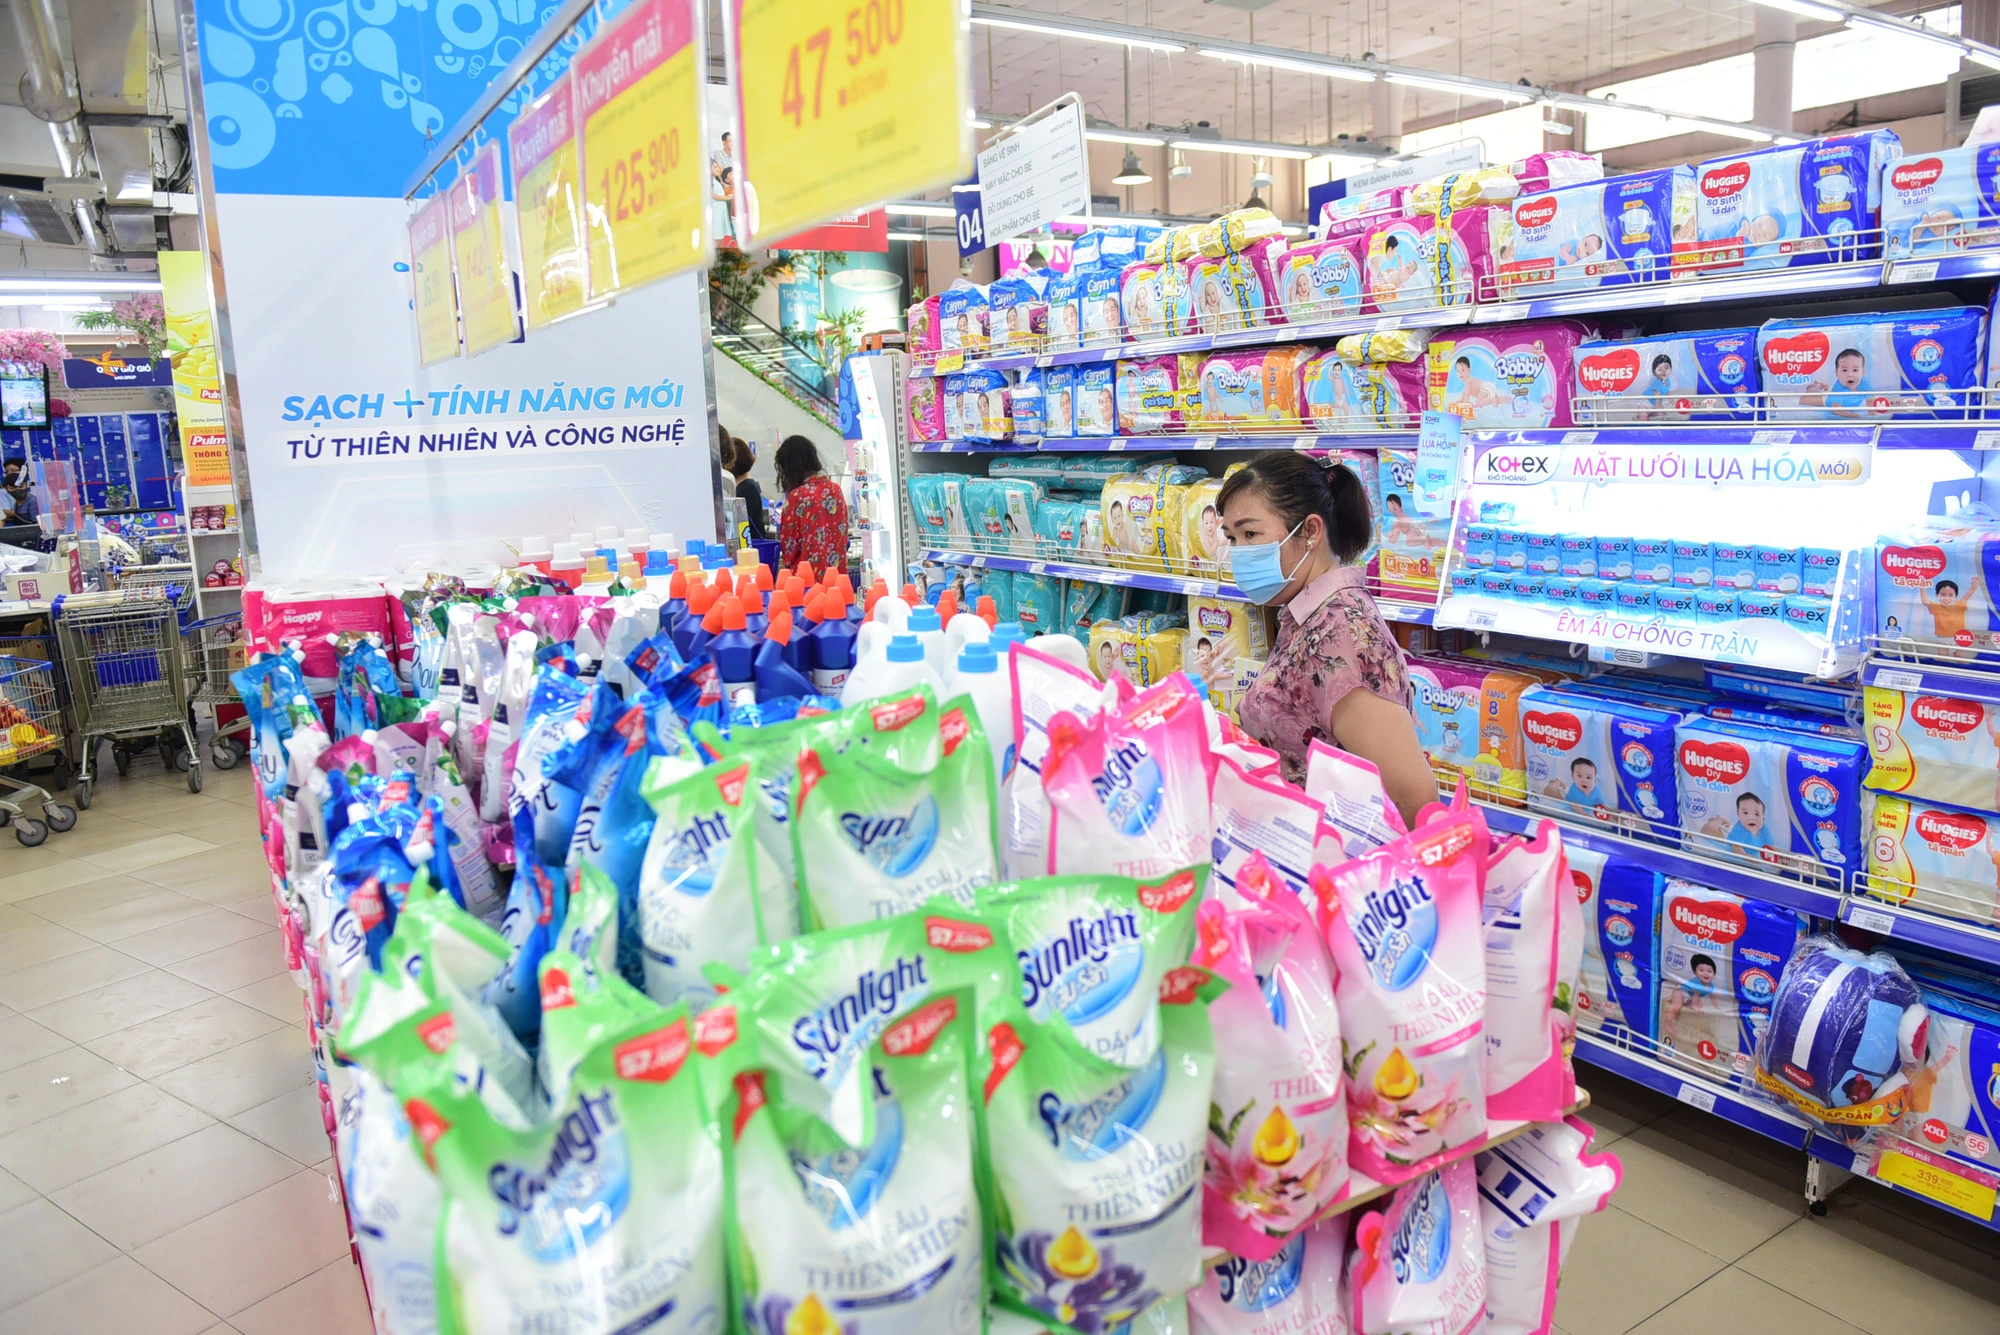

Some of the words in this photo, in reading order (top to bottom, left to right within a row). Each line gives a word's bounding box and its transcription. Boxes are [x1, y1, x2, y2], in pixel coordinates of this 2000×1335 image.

[1006, 141, 1021, 156] SINH
[985, 180, 997, 192] MAY
[1011, 166, 1024, 180] CHO
[1024, 160, 1033, 174] BÉ
[1352, 176, 1369, 189] KEM
[1370, 172, 1391, 185] ĐÁNH
[1392, 166, 1414, 179] RĂNG
[1704, 174, 1746, 190] HUGGIES
[1895, 168, 1938, 182] HUGGIES
[1718, 186, 1730, 195] Dry
[1896, 189, 1910, 198] sơ
[1911, 184, 1936, 196] sinh
[987, 203, 996, 216] ĐỒ
[996, 195, 1012, 211] DÙNG
[1012, 191, 1026, 206] CHO
[1026, 186, 1035, 199] BÉ
[1706, 198, 1719, 207] sơ
[1720, 193, 1743, 205] sinh
[1903, 197, 1914, 206] tã
[1914, 196, 1930, 205] dán
[1519, 206, 1553, 220] HUGGIES
[1712, 206, 1722, 215] tã
[1723, 204, 1737, 214] dán
[1019, 215, 1032, 229] CHO
[1033, 209, 1041, 222] BÉ
[1531, 217, 1541, 225] Dry
[958, 208, 983, 249] 04
[1521, 227, 1532, 236] sơ
[1532, 223, 1552, 233] sinh
[1526, 234, 1534, 243] tã
[1535, 233, 1547, 243] dán
[1780, 244, 1791, 252] NB
[1311, 261, 1351, 287] Bobby
[1588, 265, 1596, 275] S
[1050, 285, 1070, 300] Caryn
[1087, 279, 1110, 293] Caryn
[993, 291, 1013, 305] Caryn
[944, 299, 964, 313] Caryn
[1767, 348, 1823, 364] HUGGIES
[1495, 356, 1545, 381] Bobby
[1582, 364, 1634, 380] HUGGIES
[1787, 362, 1802, 372] Dry
[967, 375, 985, 389] Caryn
[1047, 373, 1066, 386] Caryn
[1084, 369, 1106, 383] Caryn
[1217, 371, 1251, 390] Bobby
[1775, 374, 1789, 385] tã
[1790, 374, 1810, 385] dán
[1601, 380, 1614, 389] Dry
[280, 391, 385, 428] SẠCH
[427, 383, 511, 418] TÍNH
[517, 381, 617, 413] NĂNG
[624, 378, 685, 410] MỚI
[1013, 399, 1030, 411] Caryn
[1876, 400, 1887, 409] M
[286, 433, 325, 460] TỪ
[331, 430, 411, 456] THIÊN
[418, 426, 498, 453] NHIÊN
[505, 424, 537, 448] VÀ
[544, 422, 615, 446] CÔNG
[621, 418, 686, 447] NGHỆ
[1421, 440, 1435, 450] LỤA
[1436, 438, 1452, 450] HÓA
[1487, 452, 1549, 474] kotex
[1572, 450, 1622, 482] MẶT
[1628, 451, 1686, 479] LƯỚI
[1694, 457, 1744, 486] LỤA
[1752, 451, 1816, 482] HÓA
[1819, 460, 1850, 476] MỚI
[1428, 471, 1446, 480] kotex
[1487, 473, 1501, 481] KHÔ
[1501, 473, 1527, 482] THOÁNG
[1561, 537, 1593, 550] kotex
[1633, 541, 1669, 554] kotex
[1673, 545, 1709, 558] kotex
[1714, 547, 1753, 560] kotex
[1756, 549, 1797, 563] kotex
[1420, 557, 1429, 574] 8
[1886, 553, 1942, 570] HUGGIES
[1906, 567, 1921, 576] Dry
[1482, 579, 1512, 591] kotex
[1513, 582, 1544, 595] kotex
[1894, 577, 1906, 586] tã
[1906, 575, 1933, 588] quần
[1546, 585, 1578, 598] kotex
[1580, 588, 1613, 602] kotex
[1617, 591, 1651, 606] kotex
[1656, 595, 1692, 611] kotex
[1739, 600, 1780, 616] kotex
[282, 610, 323, 625] Happy
[1785, 604, 1826, 622] kotex
[1556, 612, 1585, 634] ÊM
[1588, 613, 1608, 637] ÁI
[1612, 616, 1693, 648] CHỐNG
[1700, 631, 1759, 656] TRÀN
[1955, 633, 1973, 642] XXL
[1420, 684, 1466, 710] Bobby
[1489, 701, 1499, 716] 8
[1872, 701, 1893, 710] TẶNG
[1872, 710, 1892, 719] THÊM
[1917, 705, 1977, 725] HUGGIES
[1526, 720, 1577, 742] HUGGIES
[1938, 720, 1955, 730] Dry
[1872, 725, 1894, 753] 6
[1925, 728, 1938, 739] tã
[1940, 728, 1966, 742] quần
[1545, 738, 1559, 747] Dry
[1684, 749, 1744, 775] HUGGIES
[1706, 769, 1721, 780] Dry
[1695, 776, 1707, 788] tã
[1709, 780, 1731, 793] dán
[1816, 821, 1838, 832] MỚI
[1877, 820, 1897, 830] THÊM
[1920, 818, 1979, 841] HUGGIES
[1940, 834, 1956, 844] Dry
[1873, 834, 1896, 863] 6
[1927, 841, 1939, 853] tã
[1940, 844, 1966, 858] quần
[1675, 905, 1738, 936] HUGGIES
[1697, 925, 1714, 938] Dry
[1684, 933, 1699, 947] tã
[1701, 938, 1723, 952] dán
[1014, 907, 1142, 1010] Sunlight
[792, 952, 931, 1082] Sunlight
[1701, 1044, 1711, 1056] L
[1784, 1065, 1812, 1087] HUGGIES
[1922, 1123, 1948, 1140] XXL
[1967, 1136, 1986, 1152] 56
[1914, 1151, 1932, 1163] mãi
